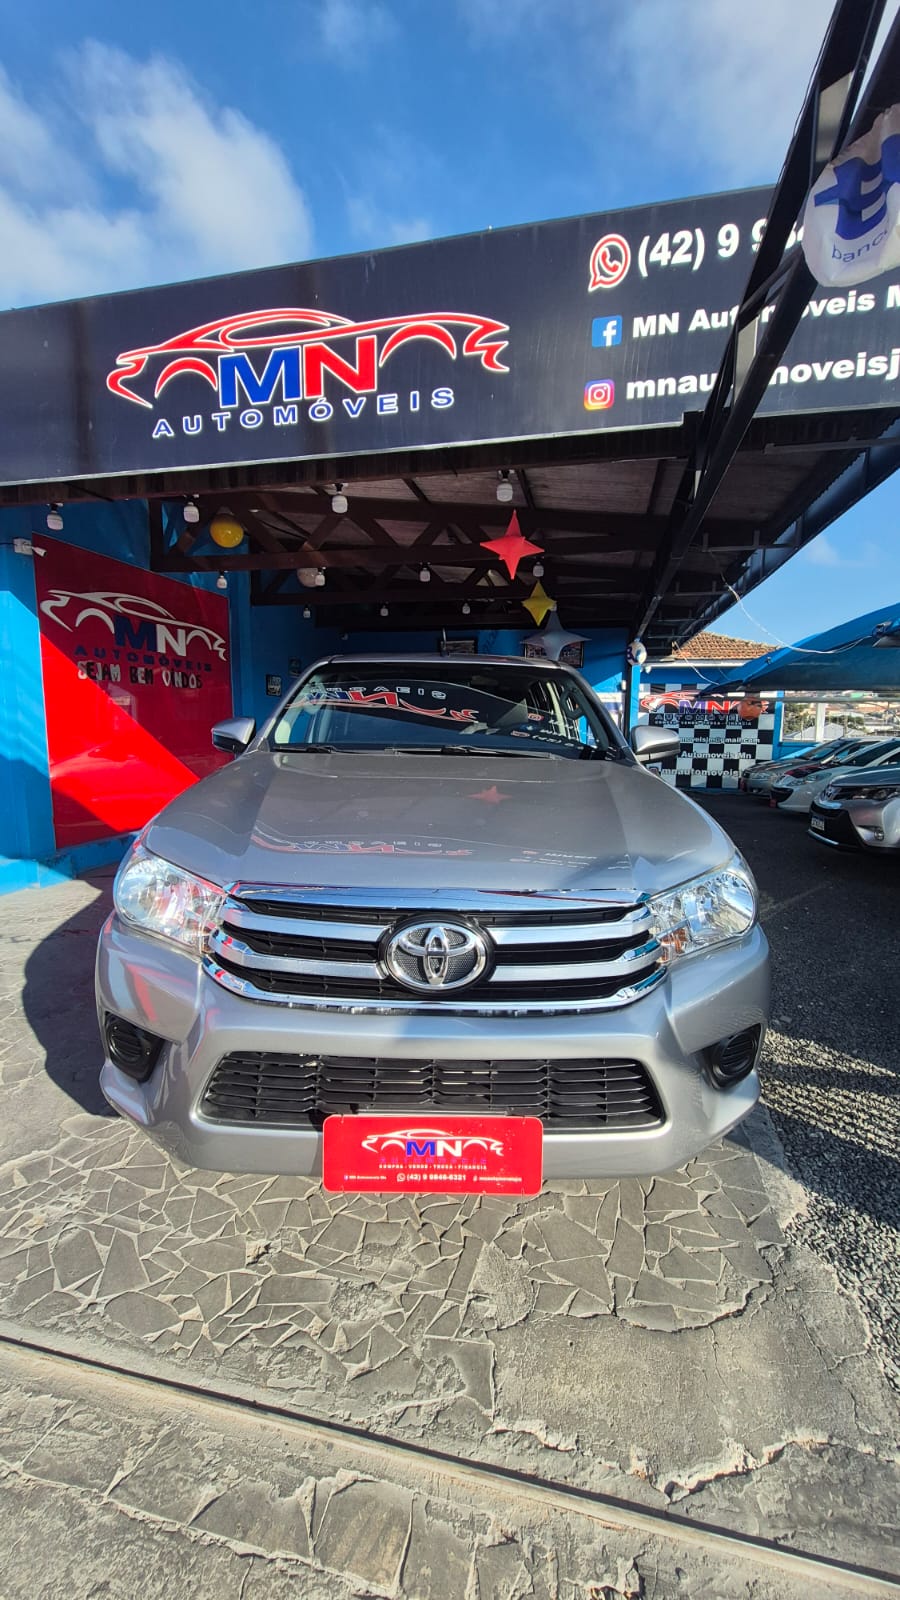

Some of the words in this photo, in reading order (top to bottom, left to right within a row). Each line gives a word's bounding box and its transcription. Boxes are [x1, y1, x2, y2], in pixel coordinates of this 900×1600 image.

[638, 228, 706, 277] (42)
[718, 223, 740, 259] 9
[632, 312, 680, 339] MN
[217, 335, 378, 409] MN
[151, 387, 456, 440] AUTOMÓVEIS
[113, 614, 187, 657] MN
[77, 660, 121, 682] SEJAM
[130, 666, 154, 685] BEM
[678, 699, 731, 714] MN
[405, 1140, 462, 1157] MN
